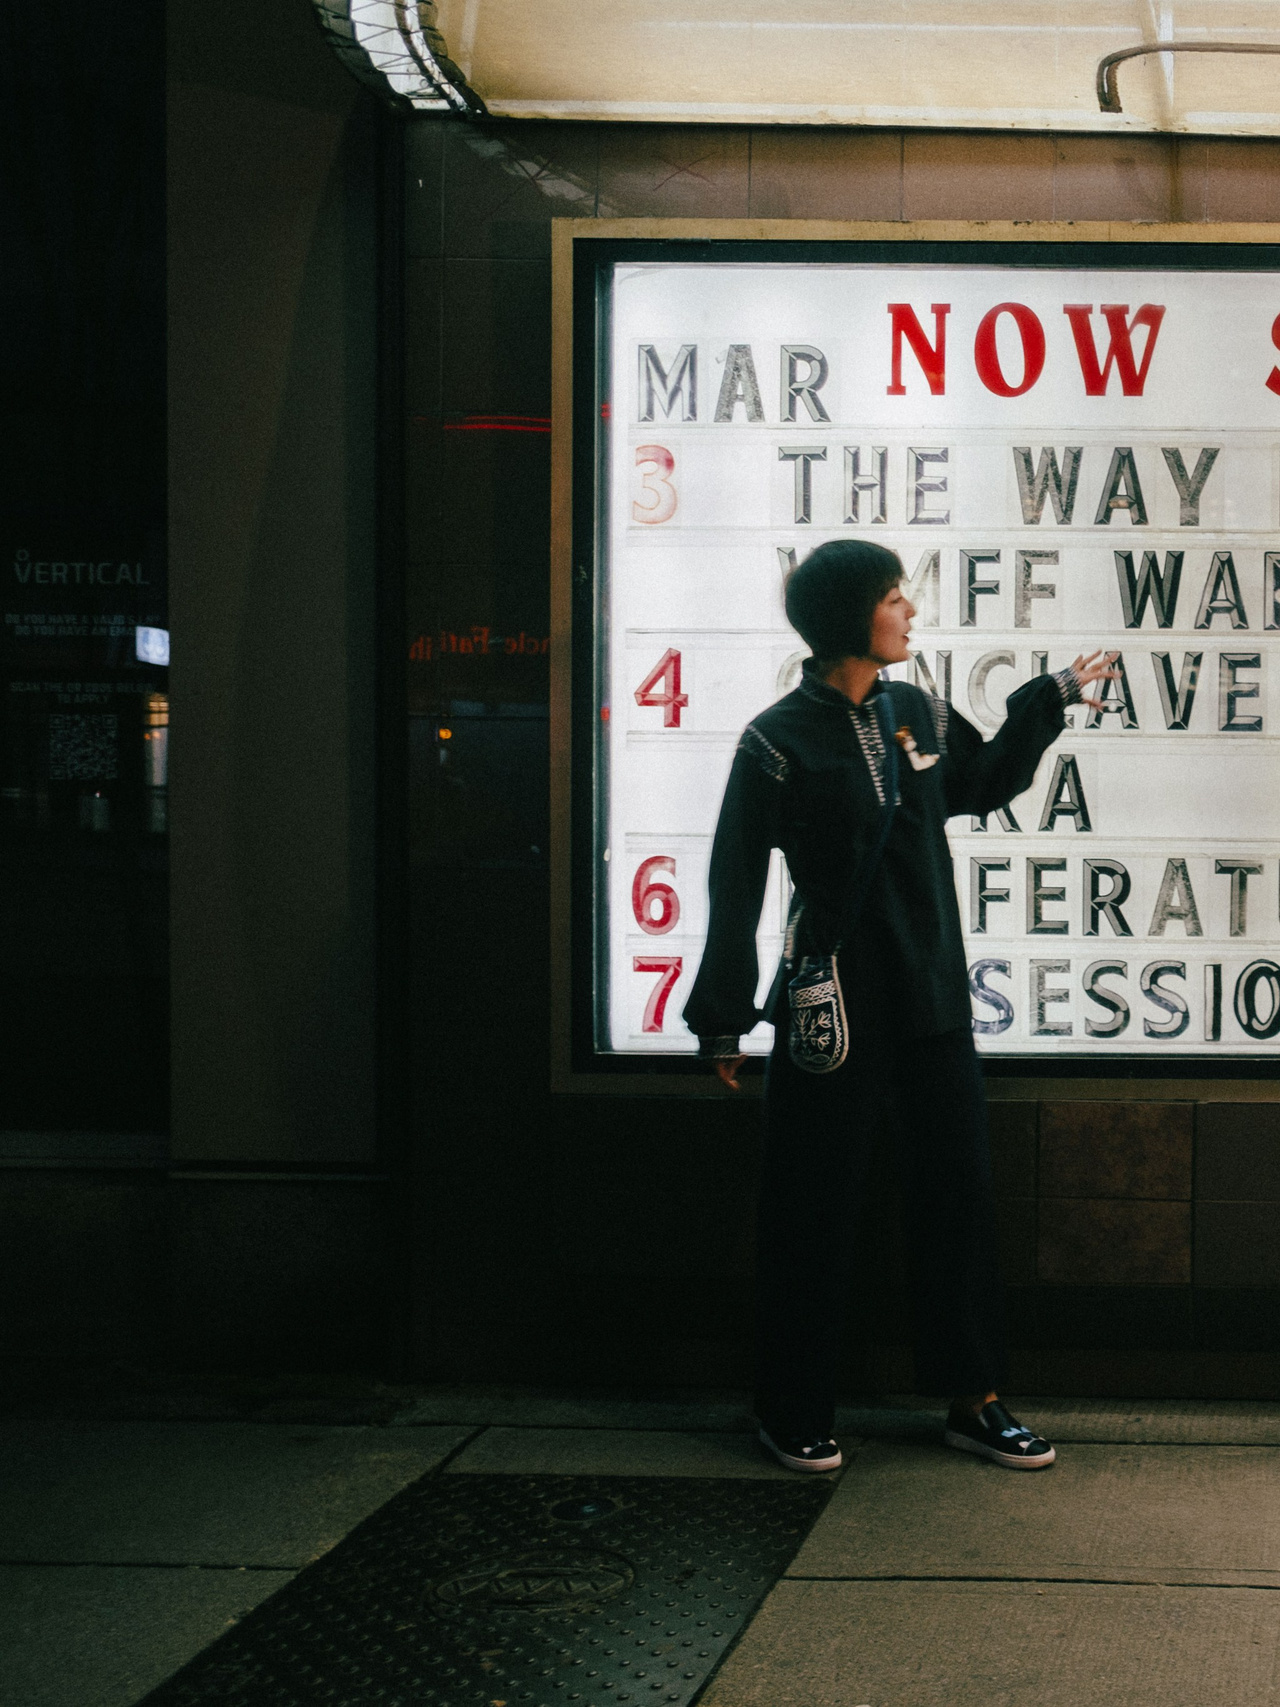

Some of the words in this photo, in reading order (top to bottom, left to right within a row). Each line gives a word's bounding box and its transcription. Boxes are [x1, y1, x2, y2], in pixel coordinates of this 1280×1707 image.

[636, 343, 833, 423] MAR
[885, 302, 1167, 398] NOW
[631, 444, 679, 525] 3
[777, 445, 951, 525] THE
[1011, 446, 1221, 526] WAY
[12, 561, 151, 586] VERTICAL
[633, 647, 690, 729] 4
[630, 854, 682, 936] 6
[631, 956, 684, 1034] 7
